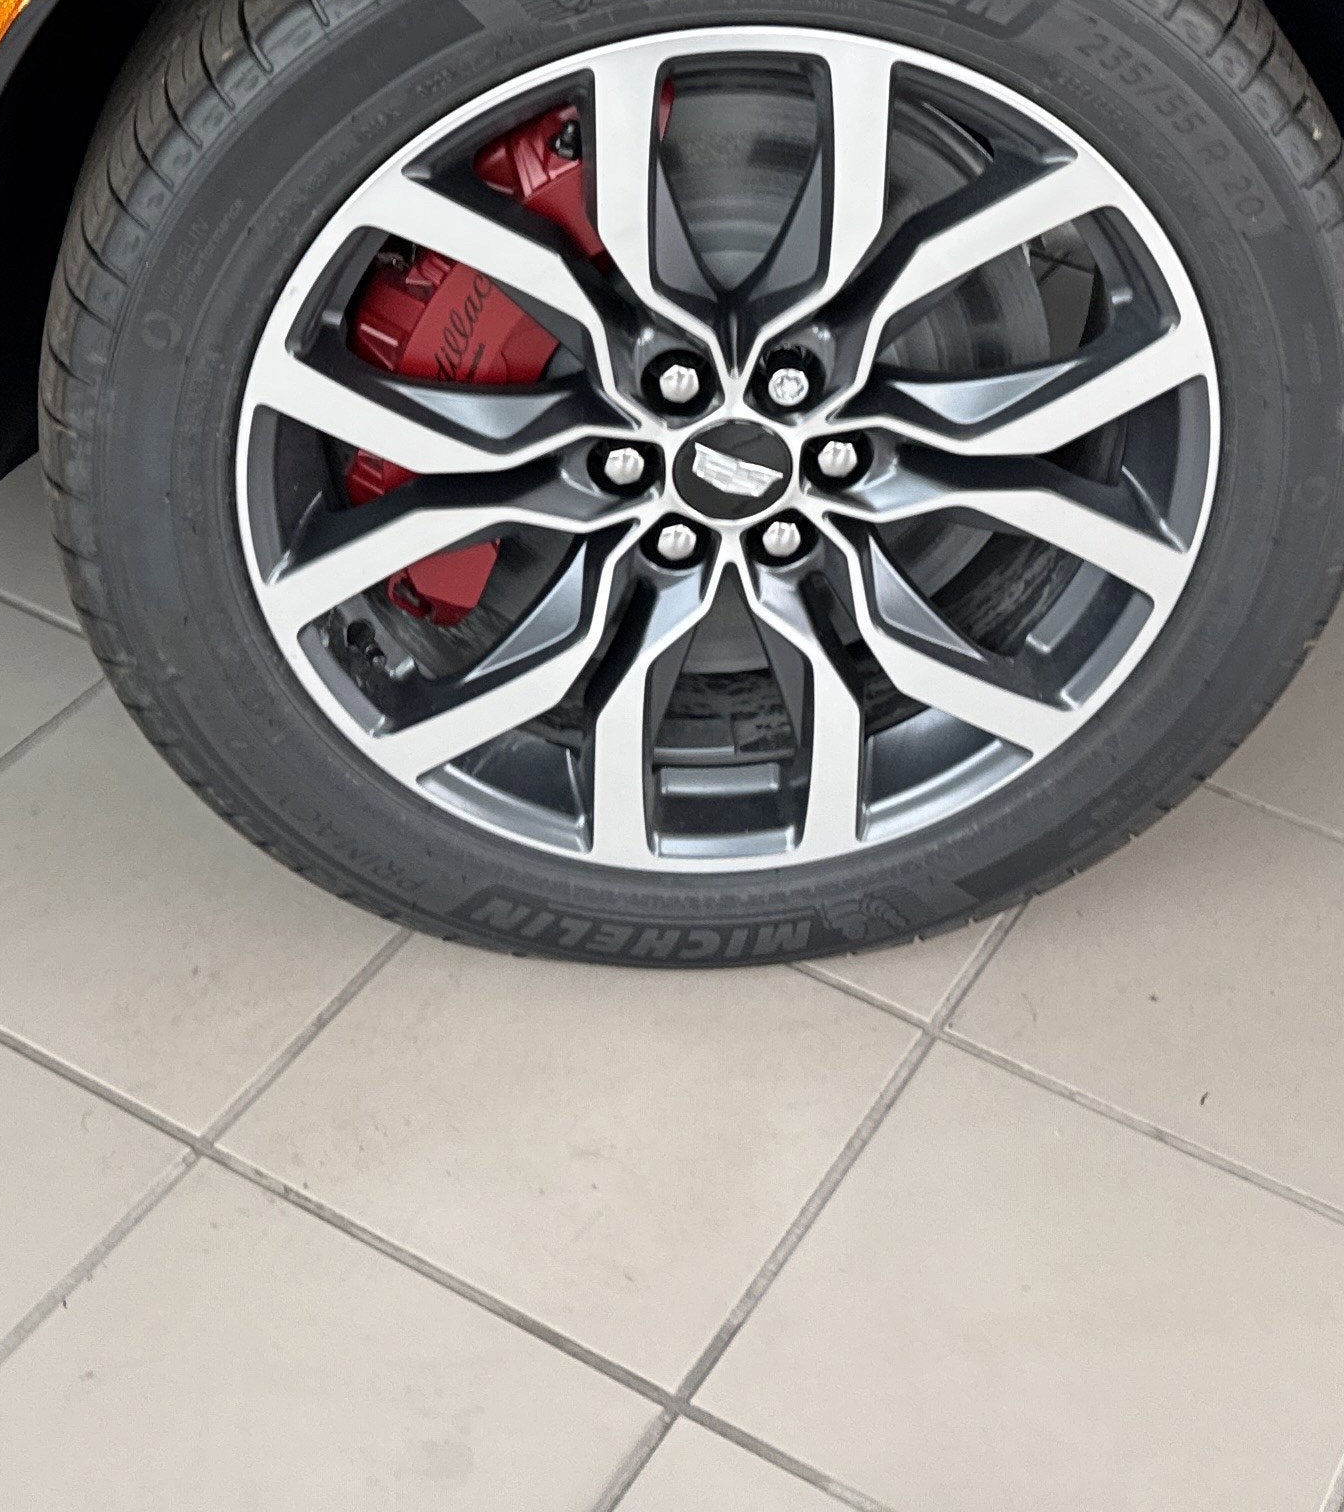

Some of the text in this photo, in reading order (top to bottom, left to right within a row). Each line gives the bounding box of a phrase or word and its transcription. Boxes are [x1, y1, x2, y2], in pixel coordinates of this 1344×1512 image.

[1075, 32, 1207, 135] 235/55
[1223, 173, 1266, 218] 20
[433, 273, 492, 381] dillac
[469, 895, 812, 960] MICHELIN
